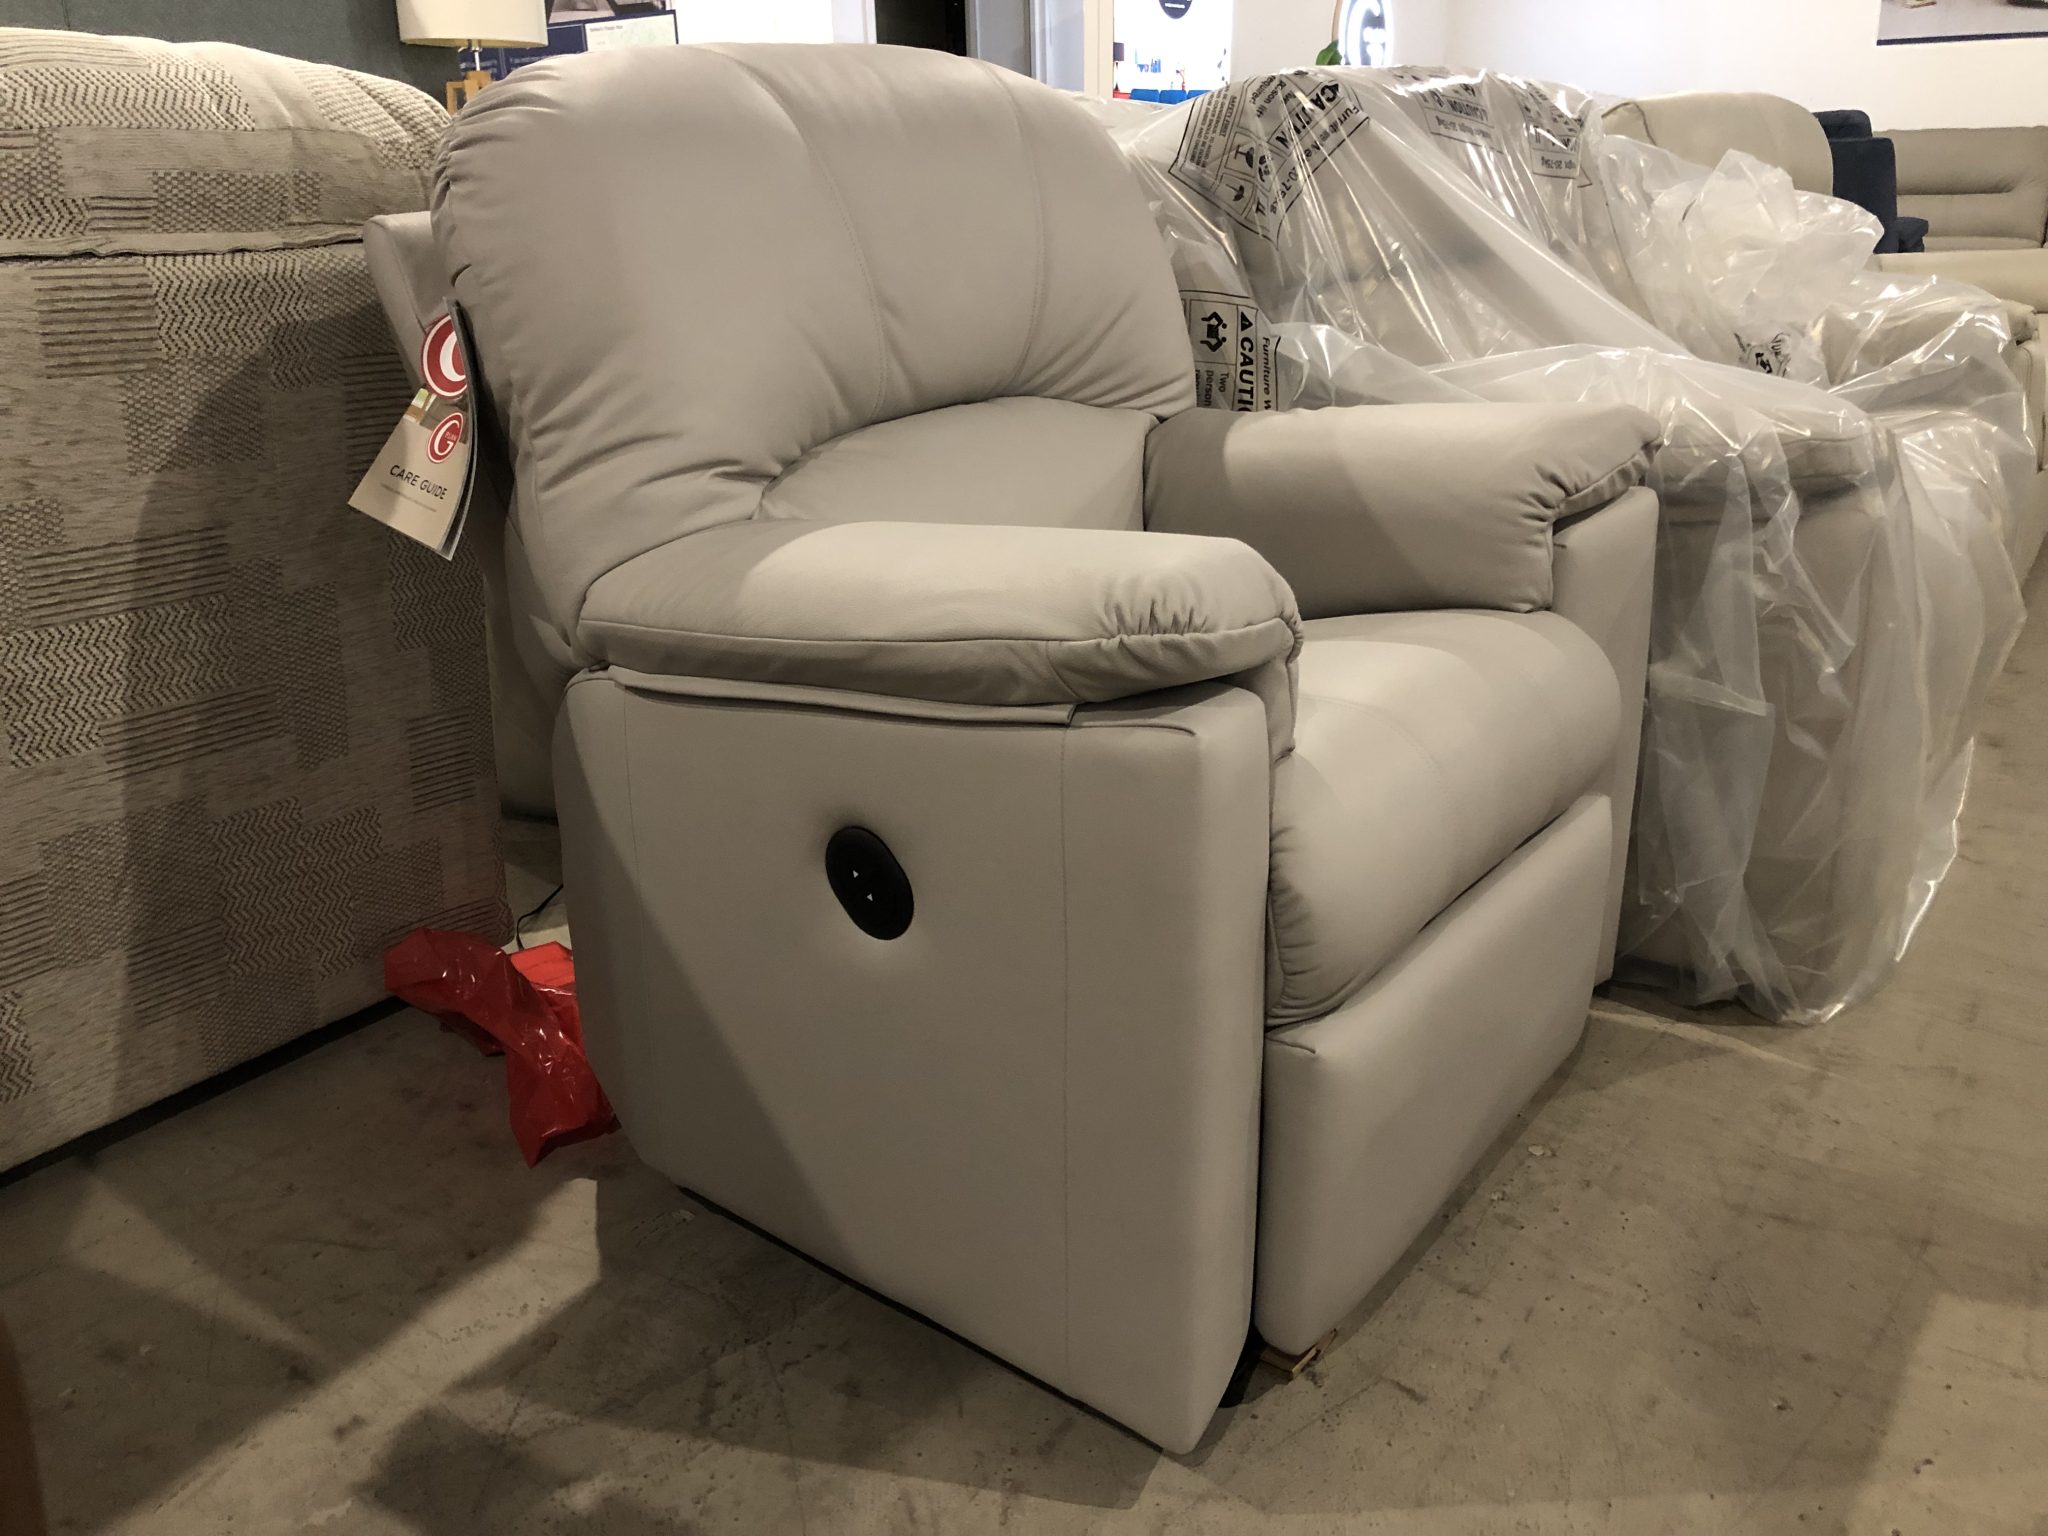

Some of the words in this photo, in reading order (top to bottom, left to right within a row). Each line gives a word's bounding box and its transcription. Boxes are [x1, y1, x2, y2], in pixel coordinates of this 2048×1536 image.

[1274, 83, 1338, 150] CAUTIN
[1204, 370, 1214, 406] person
[1219, 372, 1229, 392] Two
[389, 464, 418, 486] CARE
[419, 477, 448, 500] GUIDE
